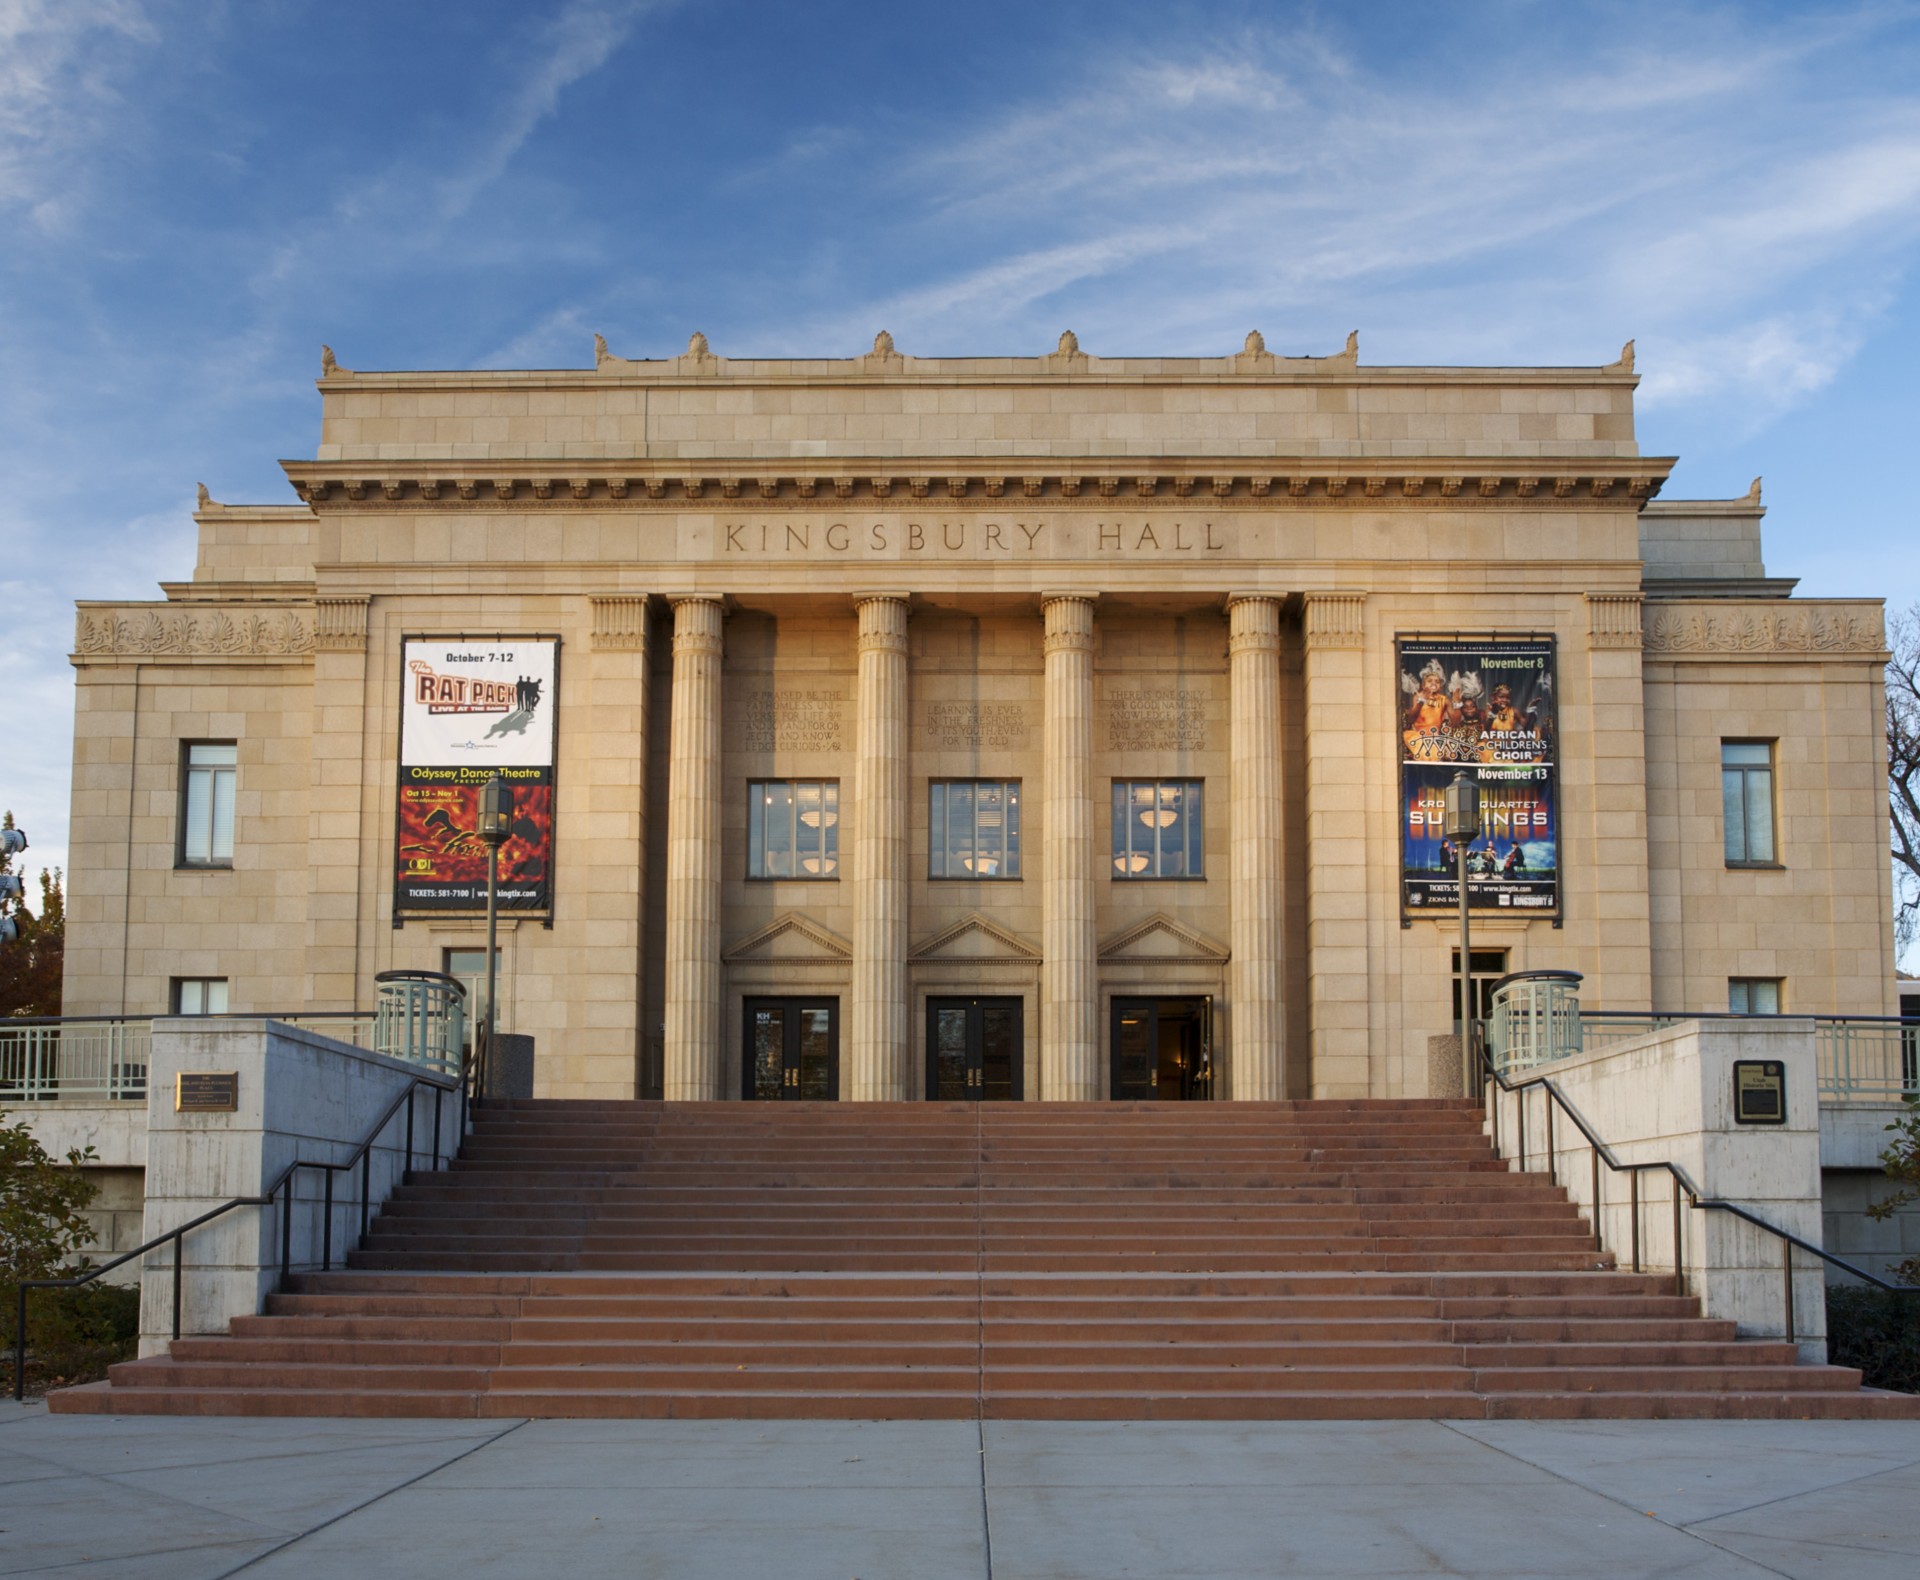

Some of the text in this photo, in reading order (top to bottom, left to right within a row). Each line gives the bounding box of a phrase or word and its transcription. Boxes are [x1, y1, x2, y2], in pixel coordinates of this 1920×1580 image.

[725, 523, 1225, 552] KINGSBURY HALL
[446, 653, 514, 662] October 7-12
[410, 660, 432, 673] The
[1480, 657, 1544, 669] November 8
[417, 673, 517, 704] RAT PACK
[807, 691, 819, 700] BE
[823, 690, 842, 700] THE
[1109, 690, 1205, 699] THERE IS ONE ONLY
[927, 706, 1023, 715] LEARNING IS EVER
[783, 712, 799, 720] FOR
[927, 716, 1023, 725] IN THE FRESHNESS
[1110, 720, 1205, 730] AND ONE ONLY
[927, 726, 939, 736] OF
[997, 726, 1024, 736] EVEN
[1480, 730, 1536, 739] AFRICAN
[780, 732, 799, 740] AND
[942, 737, 1009, 746] FOR THE OLD
[1486, 740, 1547, 749] CHILDREN'S
[1493, 751, 1533, 760] CHOIR
[411, 768, 541, 780] Odyssey Dance Theatre
[1477, 769, 1547, 779] November 13
[1479, 800, 1539, 808] QUARTET
[409, 889, 436, 897] TICKETS:
[438, 889, 469, 897] 581-7100
[1483, 885, 1532, 893] www.kingtix.com
[756, 1012, 770, 1020] KH
